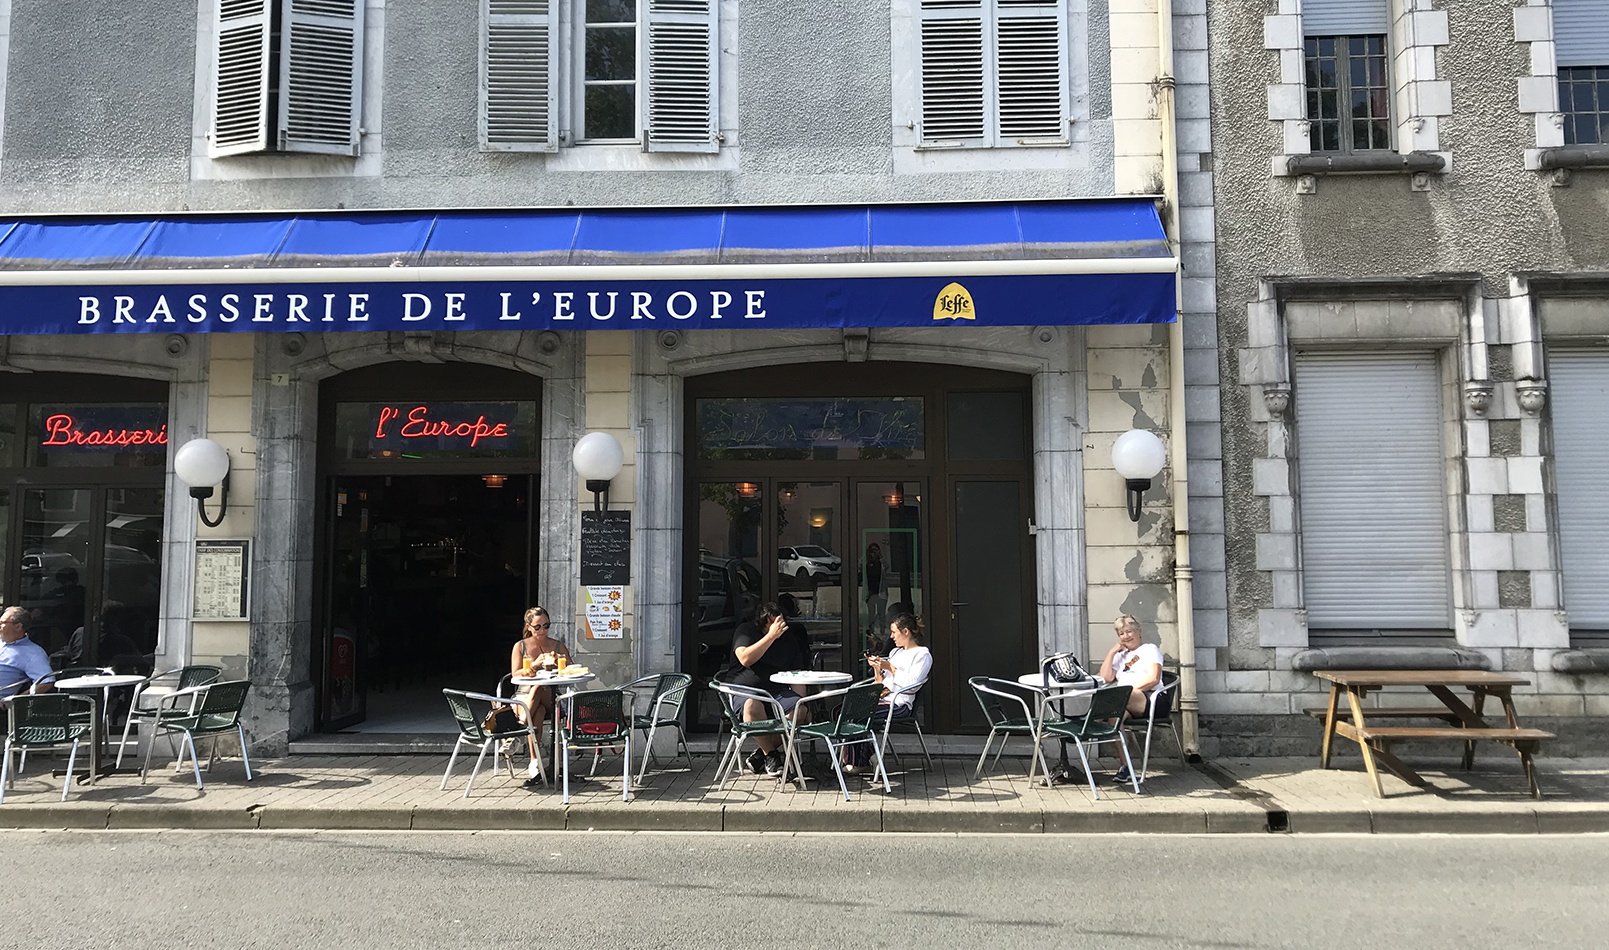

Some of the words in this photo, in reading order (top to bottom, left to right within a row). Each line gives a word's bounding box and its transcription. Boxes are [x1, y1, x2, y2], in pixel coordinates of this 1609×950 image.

[78, 293, 370, 324] BRASSERIE
[401, 292, 466, 321] DE
[499, 290, 767, 321] L'EUROPE
[939, 293, 969, 315] Leffe
[277, 375, 283, 383] 7
[42, 413, 168, 446] Brasseri
[375, 406, 509, 447] l'Europe
